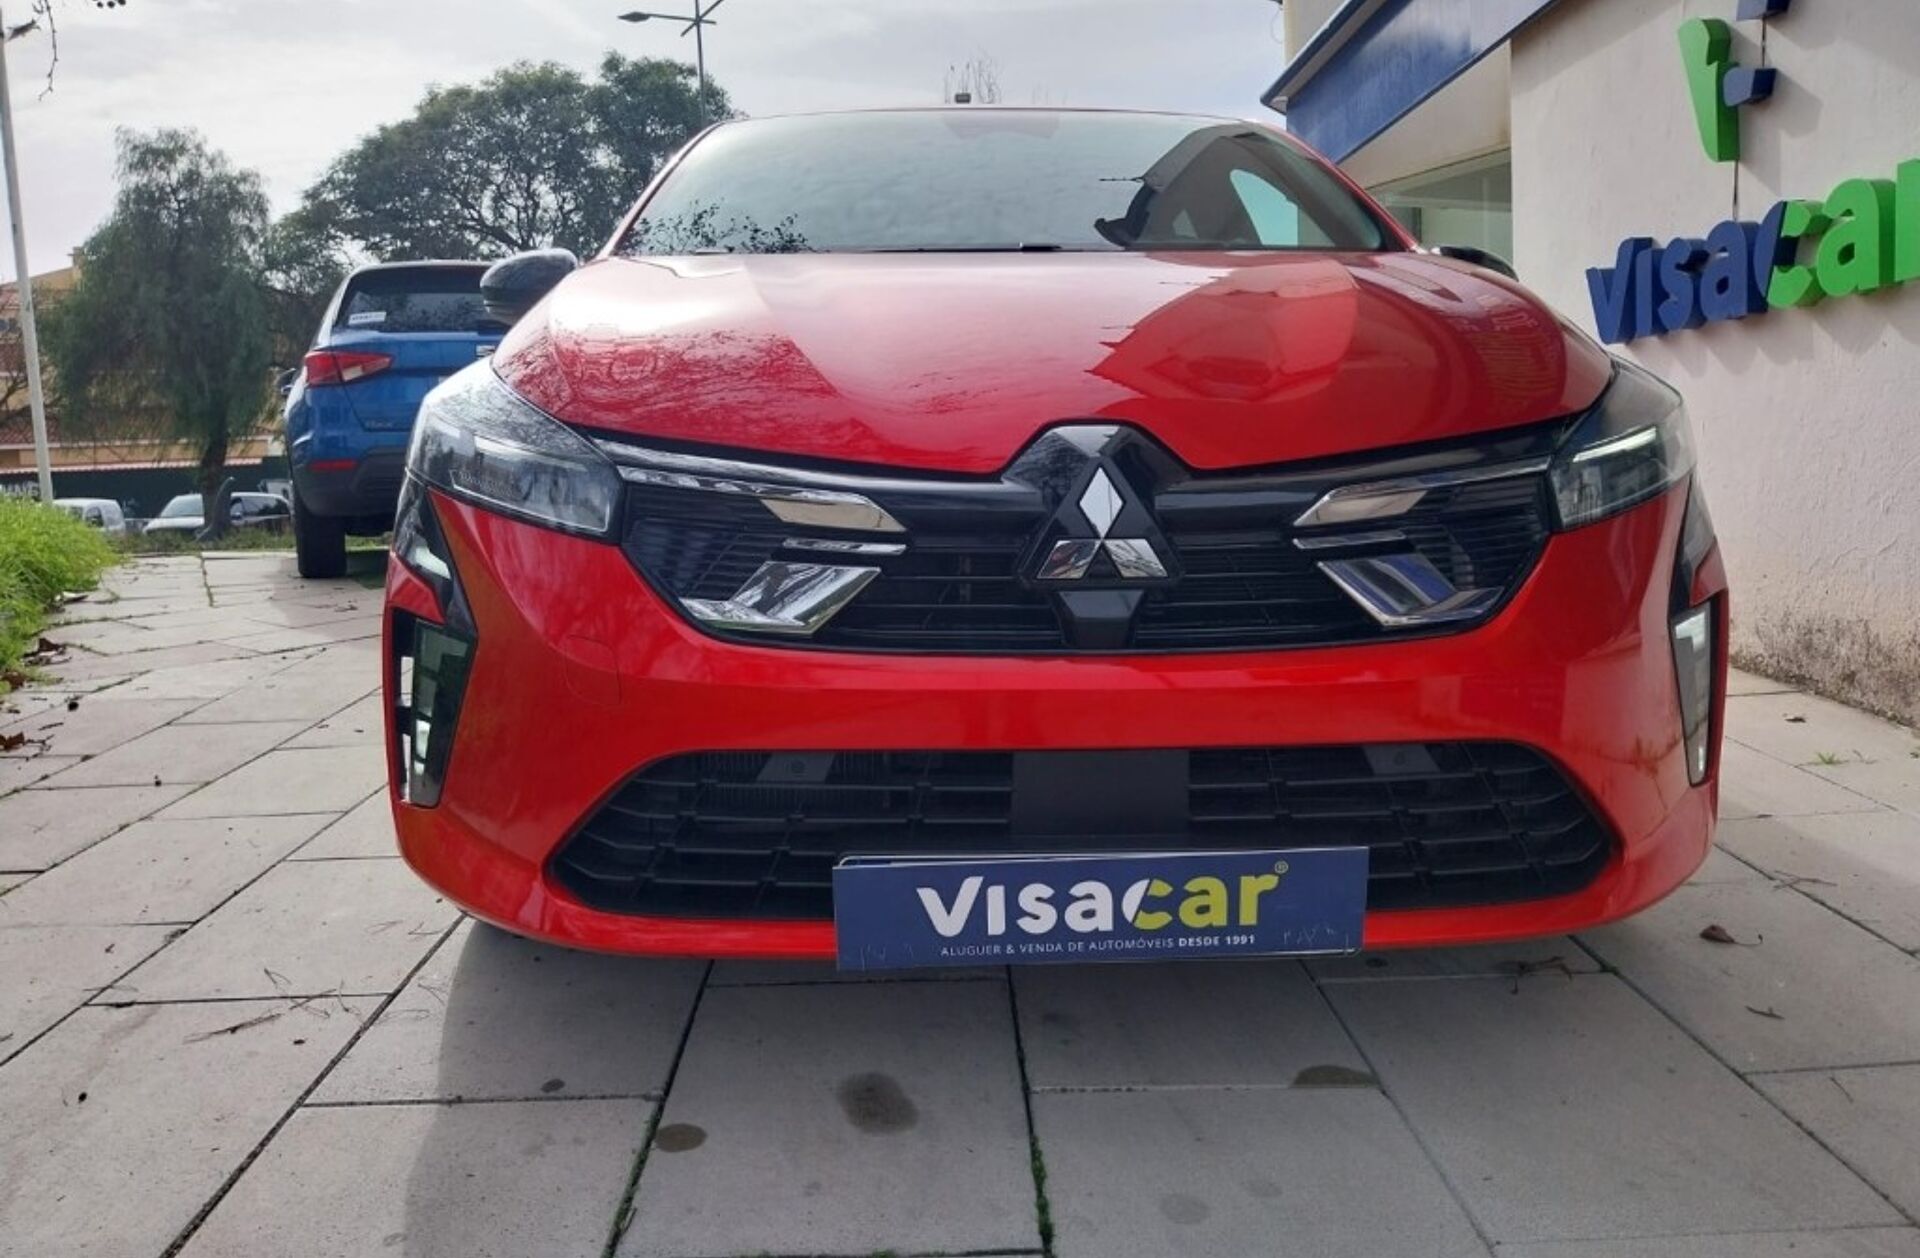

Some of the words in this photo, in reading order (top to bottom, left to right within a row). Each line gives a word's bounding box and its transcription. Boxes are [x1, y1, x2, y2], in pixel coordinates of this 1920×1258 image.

[941, 945, 1001, 956] ALUGUER
[1006, 944, 1015, 954] &
[1019, 943, 1064, 953] VENDA
[1068, 942, 1085, 951] DE
[1089, 937, 1175, 950] AUTOMÓVEIS
[1178, 937, 1220, 947] DESDE
[1225, 934, 1255, 945] 1991
